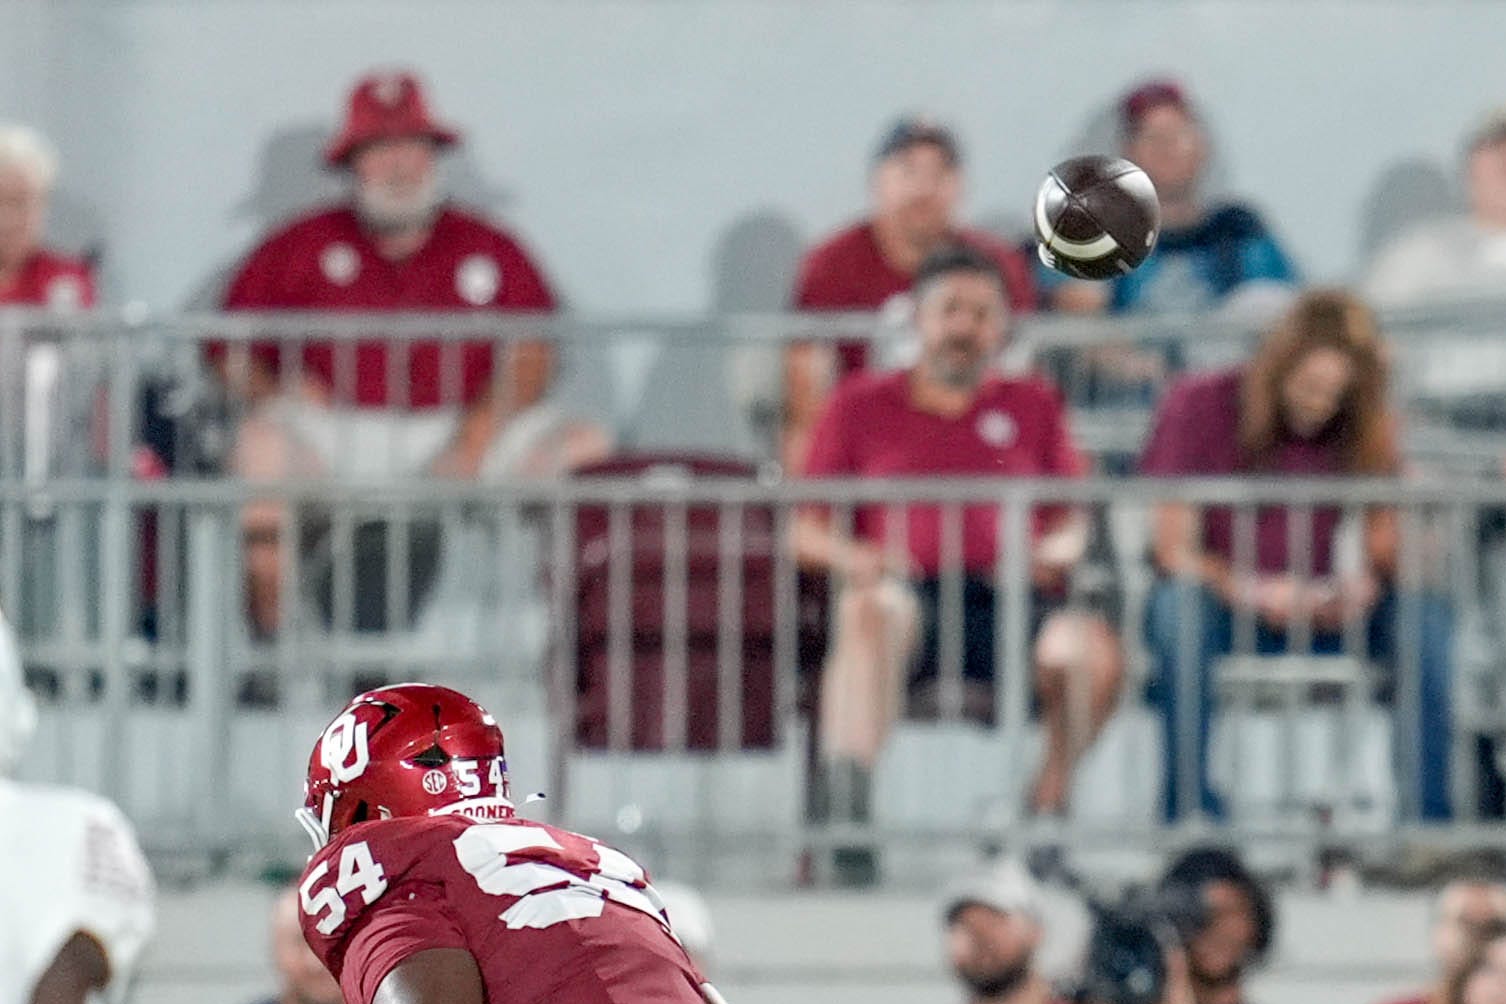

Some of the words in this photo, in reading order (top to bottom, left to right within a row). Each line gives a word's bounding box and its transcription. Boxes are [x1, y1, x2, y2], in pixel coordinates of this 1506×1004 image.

[451, 757, 504, 799] 54
[451, 805, 515, 819] OONER
[299, 841, 388, 935] 54
